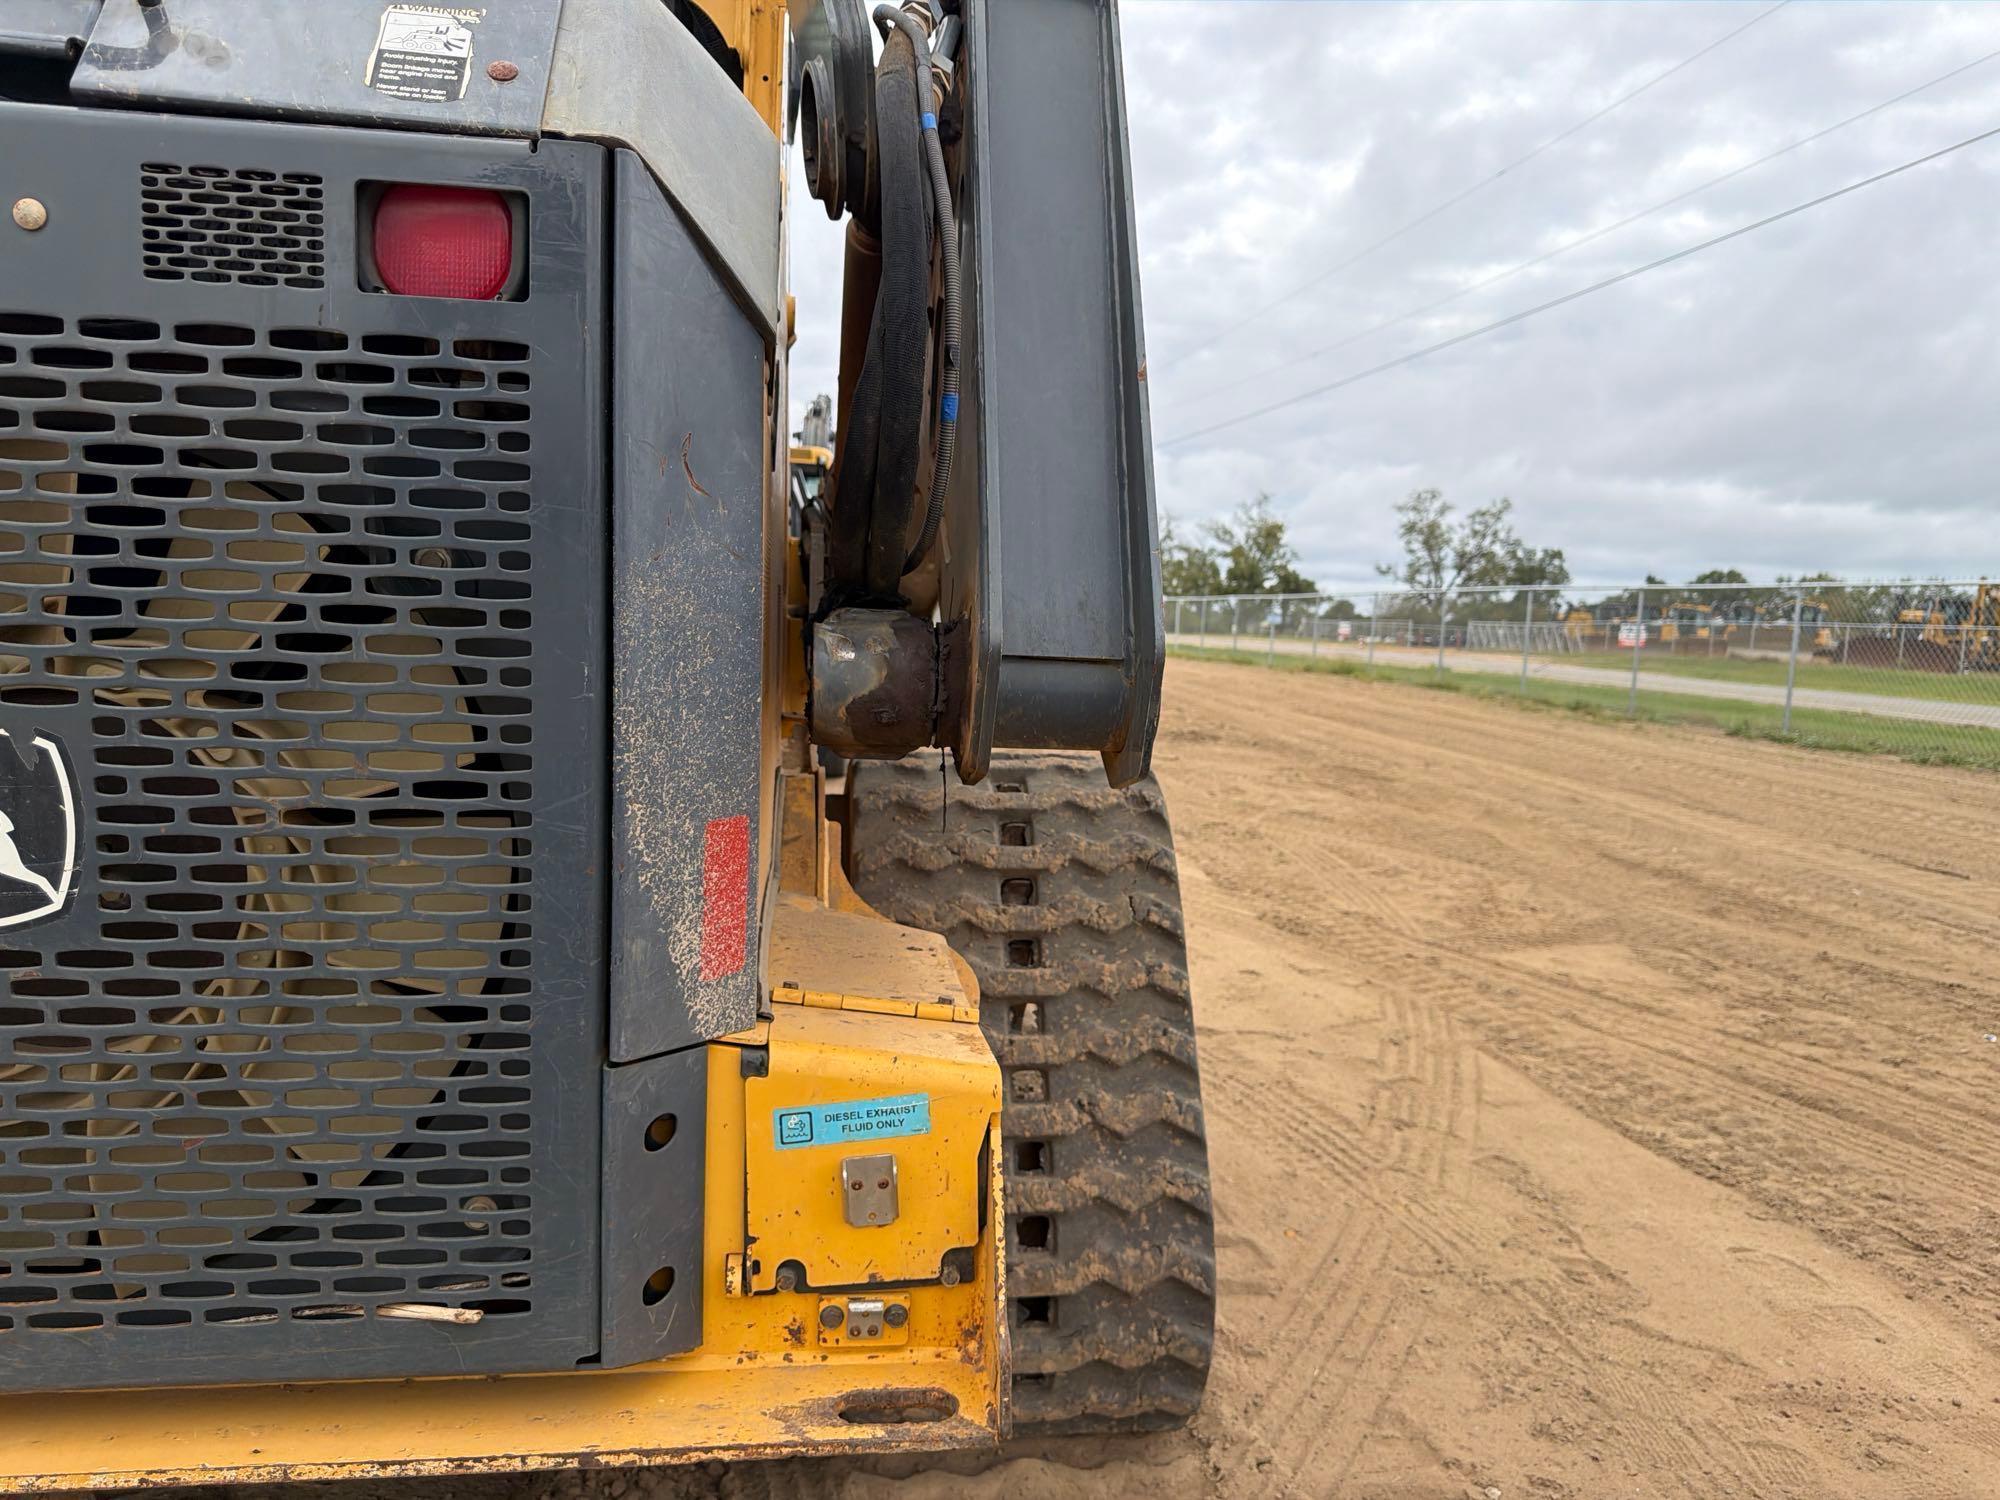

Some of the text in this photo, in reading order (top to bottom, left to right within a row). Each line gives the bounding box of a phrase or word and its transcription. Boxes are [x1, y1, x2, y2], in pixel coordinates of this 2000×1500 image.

[405, 54, 436, 63] crushing
[404, 64, 430, 72] linkage
[824, 1105, 918, 1123] DIESEL EXHAUST
[841, 1118, 905, 1133] FLUID ONLY
